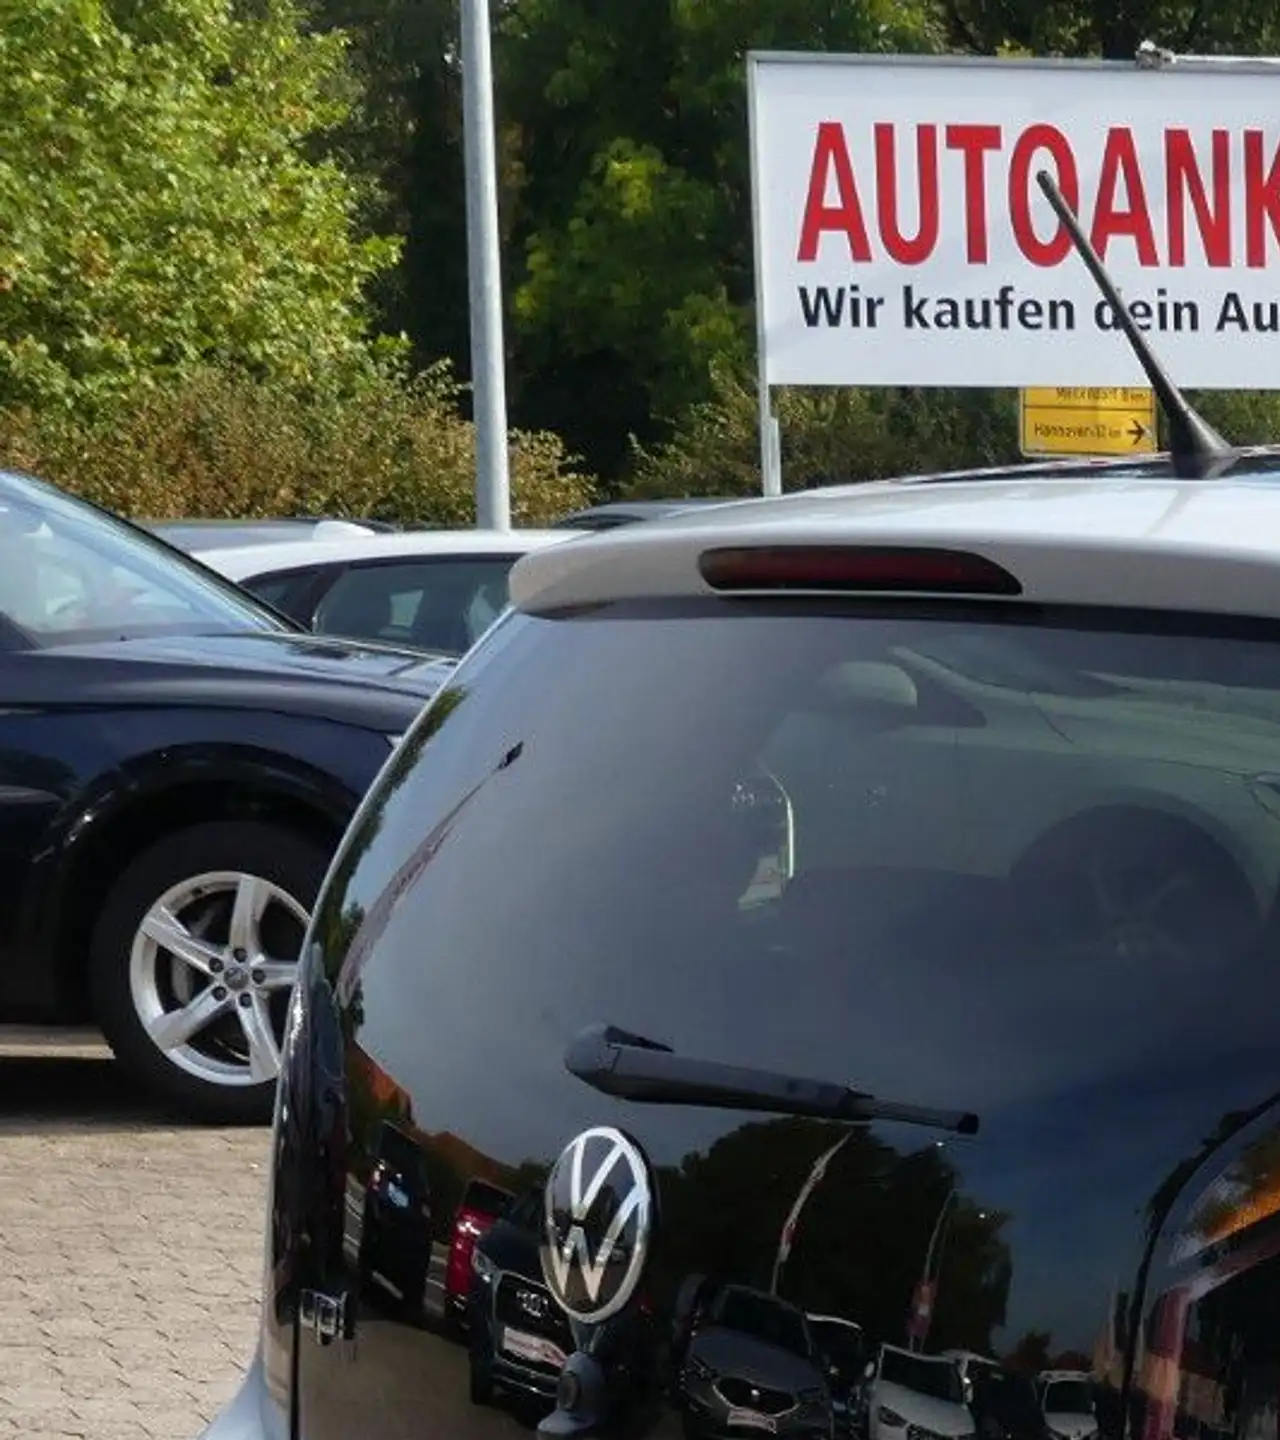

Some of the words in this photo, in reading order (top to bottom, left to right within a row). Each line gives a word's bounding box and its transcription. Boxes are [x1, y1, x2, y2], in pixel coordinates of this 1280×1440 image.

[798, 284, 884, 328] Wir
[903, 285, 1075, 331] kaufen
[1094, 286, 1199, 333] dein
